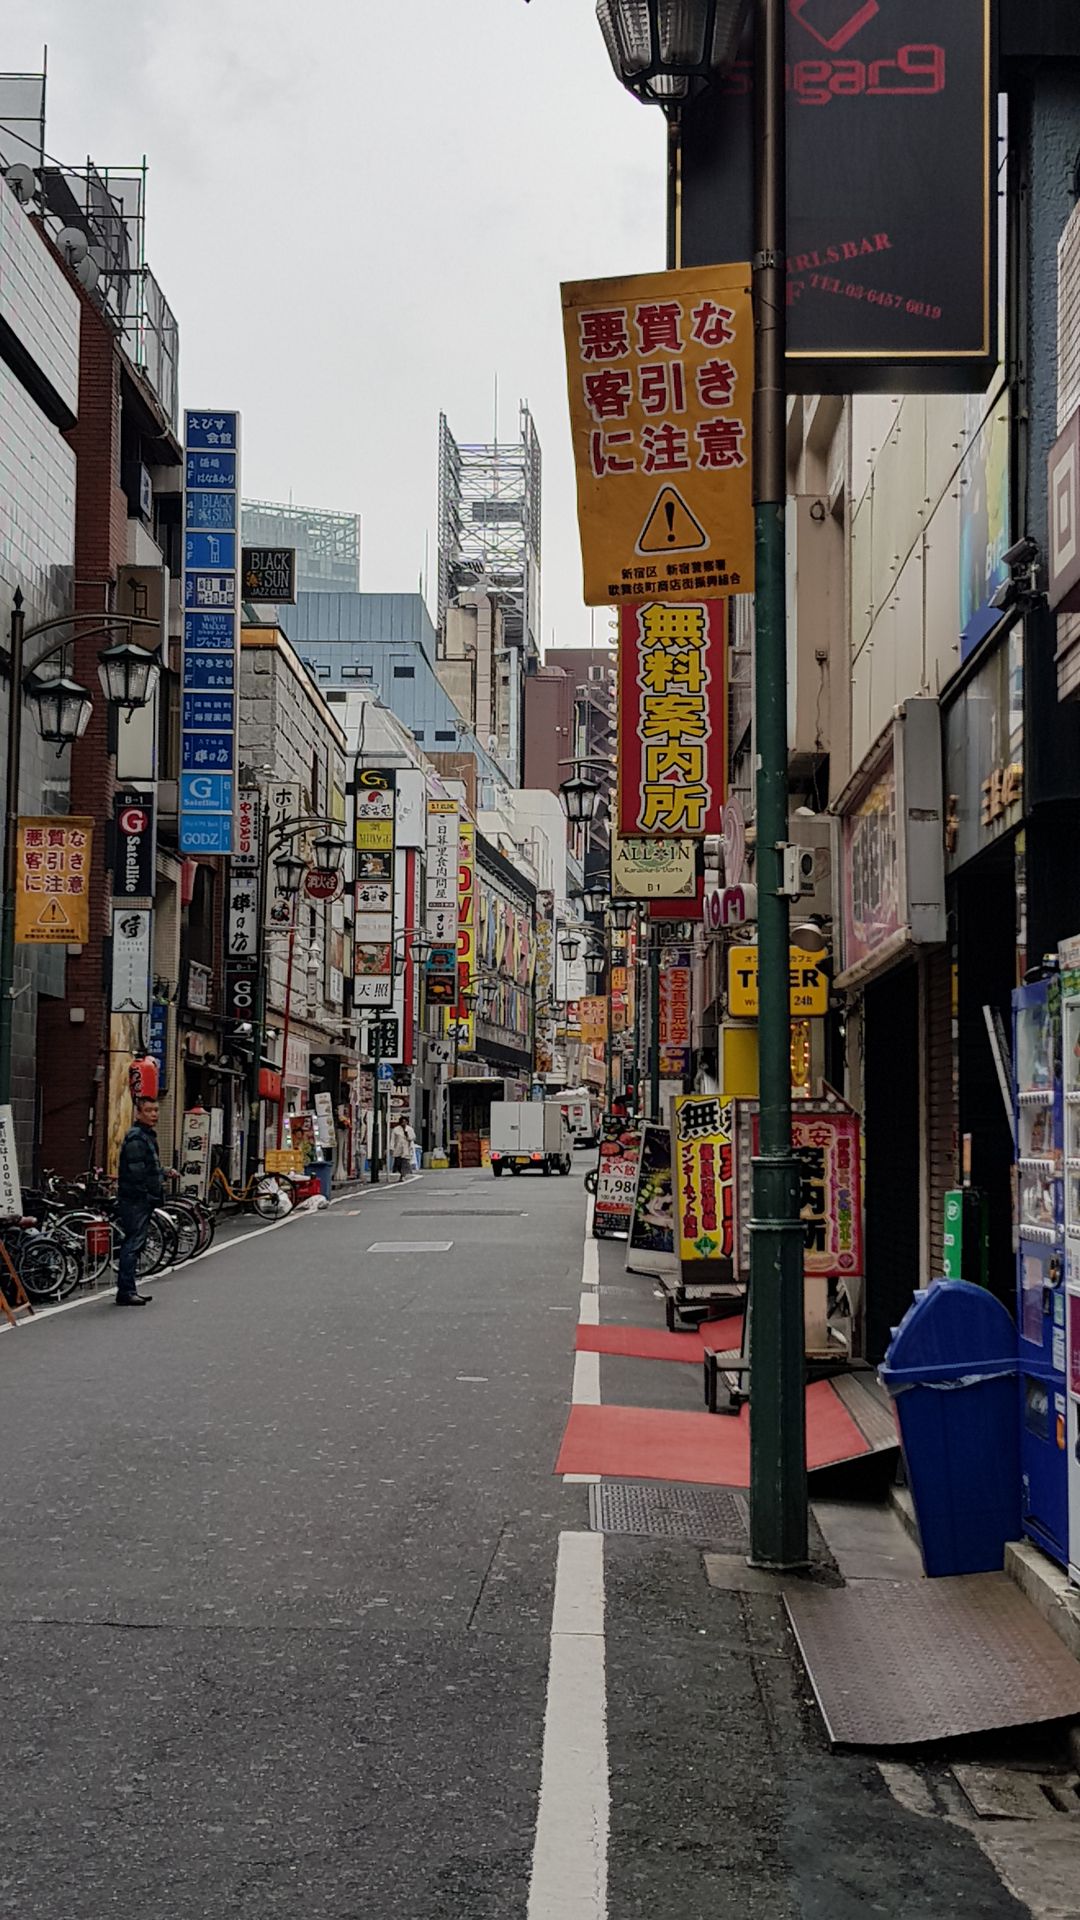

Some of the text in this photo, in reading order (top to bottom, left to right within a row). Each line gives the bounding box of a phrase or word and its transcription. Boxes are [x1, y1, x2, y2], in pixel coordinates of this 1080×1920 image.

[720, 44, 946, 105] sgar9
[786, 233, 894, 273] IRLS BAR
[578, 301, 735, 360] 悪質な
[584, 361, 737, 419] 客引き
[189, 417, 226, 430] えびす
[206, 433, 232, 444] 会館
[590, 420, 746, 476] に注意
[187, 460, 194, 479] 4F
[202, 494, 232, 507] BLACK
[251, 552, 290, 570] BLACK
[265, 570, 290, 588] SUN
[622, 565, 658, 579] 新宿区
[186, 621, 192, 640] 2F
[196, 658, 233, 668] やきとり
[642, 604, 707, 830] 無料案内所
[189, 777, 213, 799] G
[121, 810, 144, 834] G
[240, 802, 253, 852] やきとり
[25, 829, 85, 847] 悪質な
[182, 833, 219, 845] GODZ
[25, 852, 83, 870] 客引き
[617, 846, 690, 861] ALL IN
[125, 836, 140, 893] Satellite
[25, 876, 83, 894] に注意
[737, 969, 820, 988] TiER
[358, 984, 390, 997] 天照
[793, 995, 813, 1006] 24h
